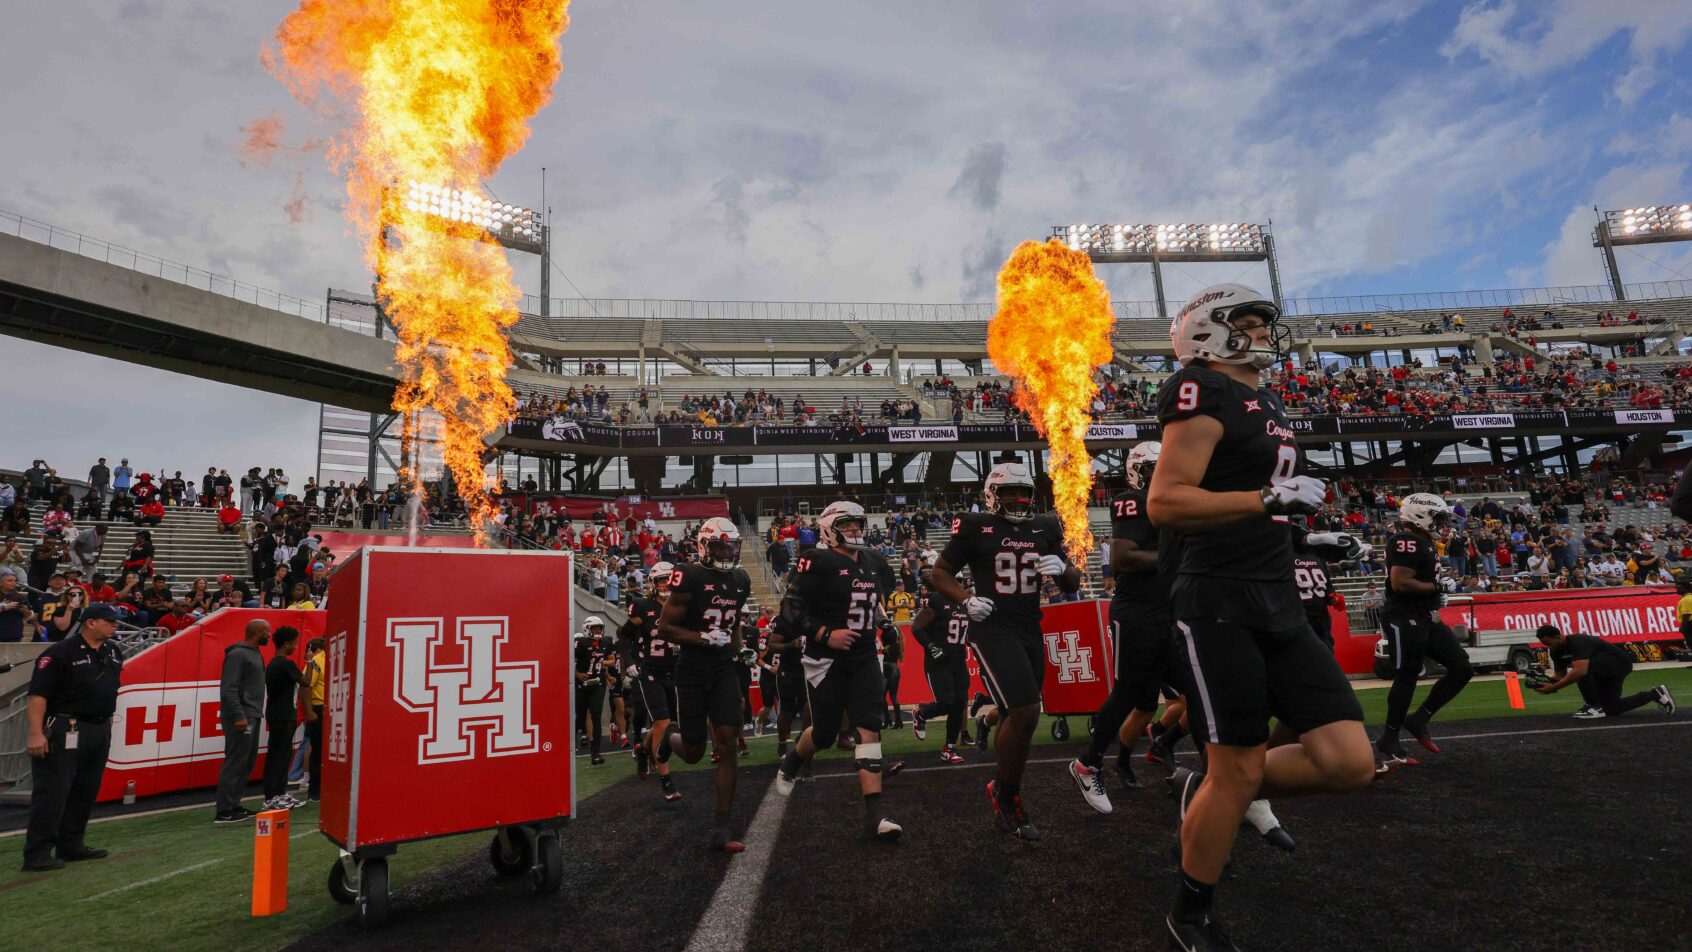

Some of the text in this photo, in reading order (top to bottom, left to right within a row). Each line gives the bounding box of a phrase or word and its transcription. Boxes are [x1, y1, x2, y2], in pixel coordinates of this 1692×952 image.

[1177, 382, 1198, 411] 9
[1454, 416, 1513, 426] WEST VIRGINIA
[1626, 412, 1662, 421] HOUSTON
[587, 427, 619, 436] HOUSTON
[891, 428, 956, 439] WEST VIRGINIA
[139, 488, 148, 496] 77
[1114, 500, 1137, 517] 72
[1409, 497, 1441, 508] Houston
[1001, 538, 1034, 549] Cougars
[1396, 541, 1417, 553] 35
[797, 558, 812, 573] 51
[995, 552, 1040, 594] 92
[847, 592, 878, 630] 51
[1577, 607, 1643, 637] ALUMNI
[947, 619, 969, 645] 97
[1043, 630, 1096, 684] UH
[385, 615, 540, 765] UH
